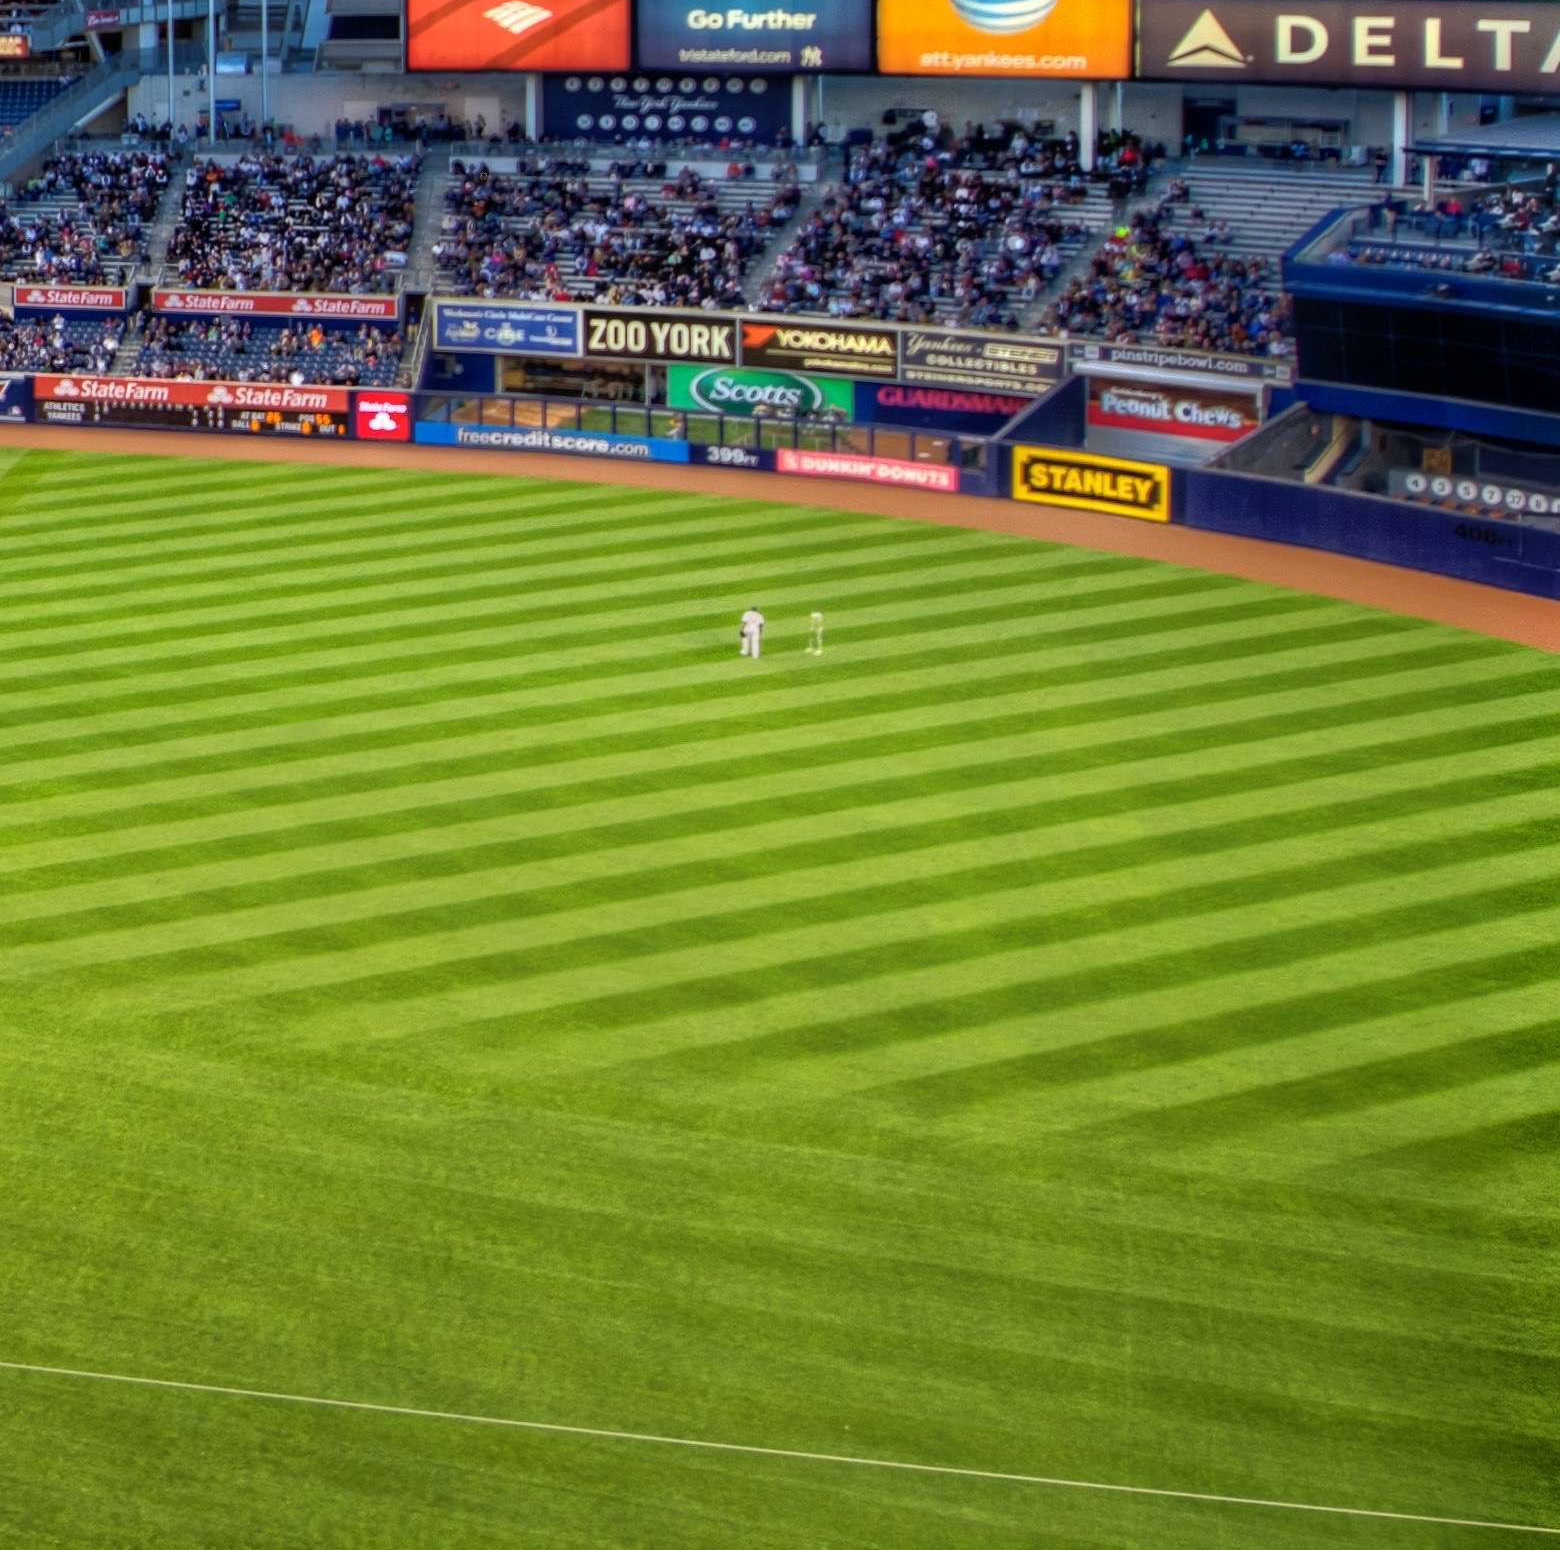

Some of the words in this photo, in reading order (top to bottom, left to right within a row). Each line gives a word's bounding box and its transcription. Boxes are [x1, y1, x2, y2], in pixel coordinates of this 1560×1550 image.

[687, 9, 723, 29] Go
[726, 8, 817, 30] Further
[589, 318, 647, 353] ZOO
[650, 321, 732, 359] YORK
[775, 328, 894, 357] YOKOHAMA
[926, 353, 1038, 376] COLLECTIBLES
[1111, 350, 1248, 374] pinstripebowl.com
[81, 380, 125, 399] State
[126, 382, 170, 400] Farm
[235, 387, 281, 406] State
[282, 388, 328, 408] Farm
[709, 376, 803, 406] Scotts
[1102, 392, 1171, 420] Peanut
[1175, 401, 1243, 429] Chews
[457, 426, 650, 458] freecreditscore.com
[800, 456, 877, 478] DUNKIN'
[877, 463, 951, 487] DONUTS
[1030, 462, 1155, 505] STANLEY
